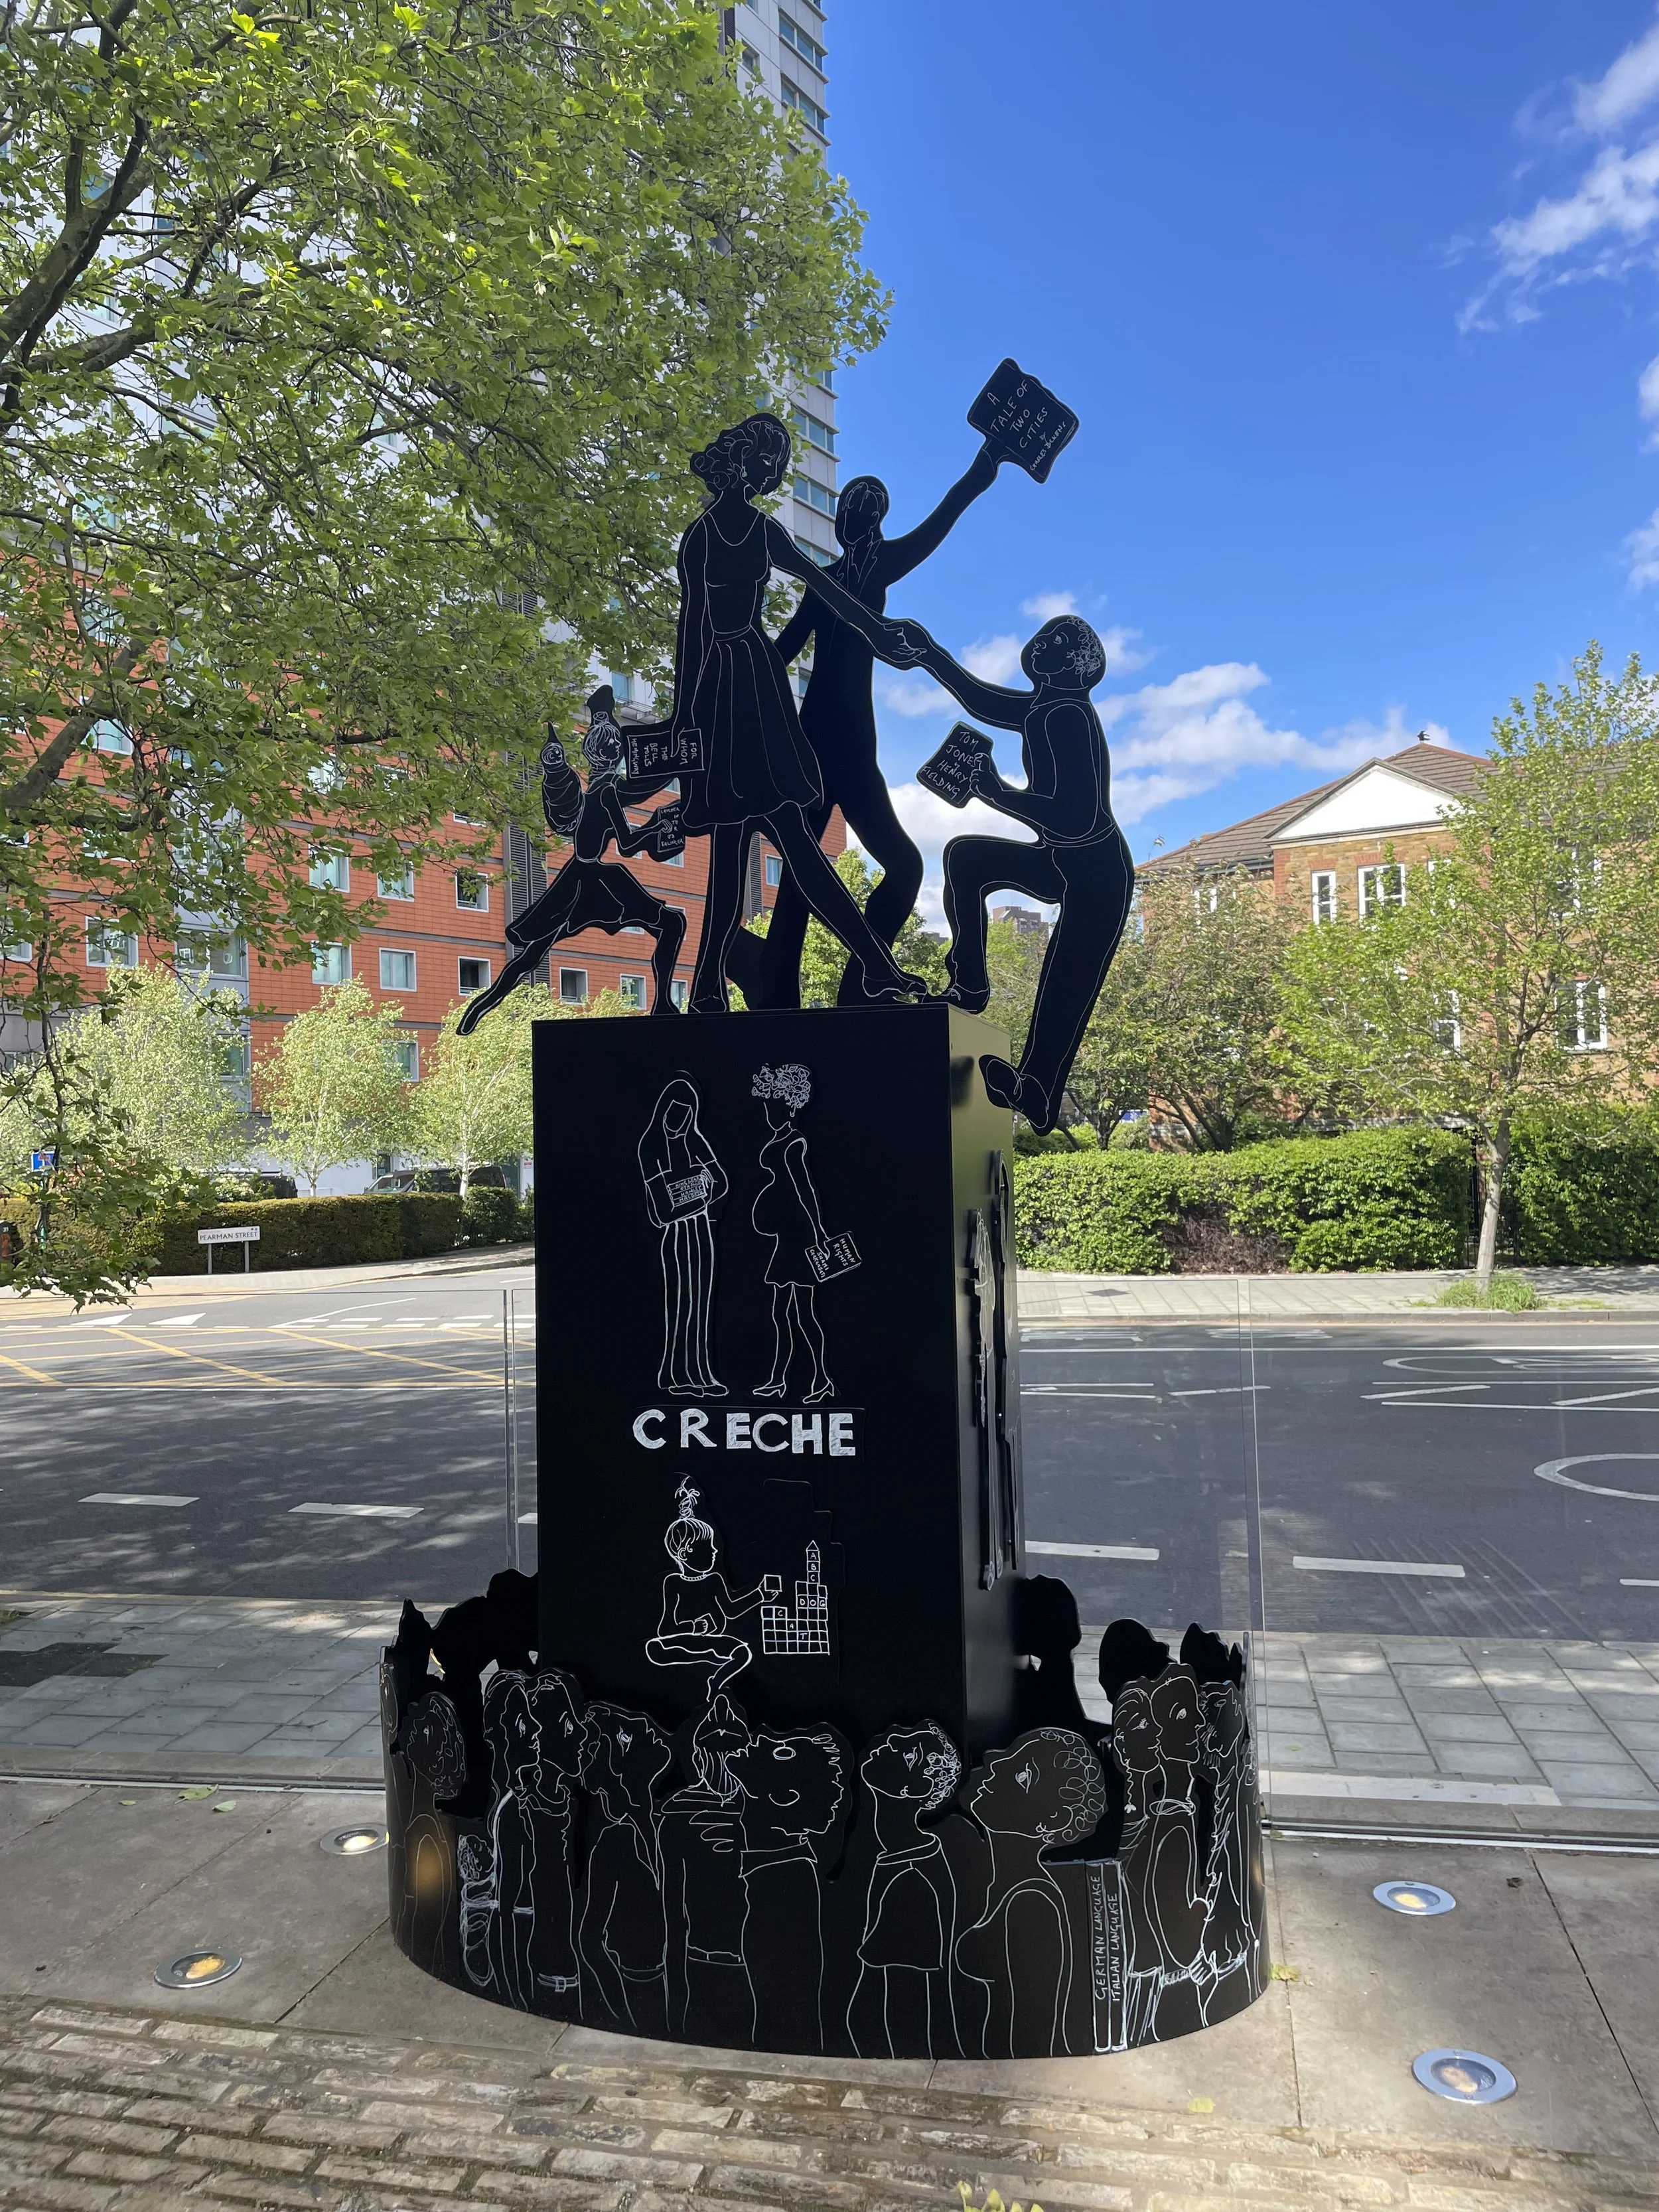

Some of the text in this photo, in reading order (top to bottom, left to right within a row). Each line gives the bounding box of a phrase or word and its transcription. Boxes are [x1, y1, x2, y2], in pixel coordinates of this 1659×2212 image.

[987, 392, 1001, 406] A
[990, 379, 1029, 433] TALE OF
[1009, 409, 1031, 432] TWO
[1019, 407, 1048, 449] CITIES
[650, 743, 658, 763] BELL
[679, 738, 688, 765] WHOM
[960, 731, 979, 753] TOM
[644, 745, 652, 767] TOLLS
[920, 765, 961, 800] FIELDING
[936, 759, 969, 784] HENRY
[200, 1232, 234, 1241] PEARMAN
[817, 1252, 830, 1271] SHAMI
[833, 1242, 849, 1266] RIGHTS
[839, 1238, 856, 1263] HUMAN
[632, 1408, 856, 1456] CRECHE
[799, 1597, 826, 1607] DOG
[1090, 1876, 1107, 2000] GERMAN LANGUAGE
[1107, 1893, 1120, 2002] ITALIAN LANGUAGE
